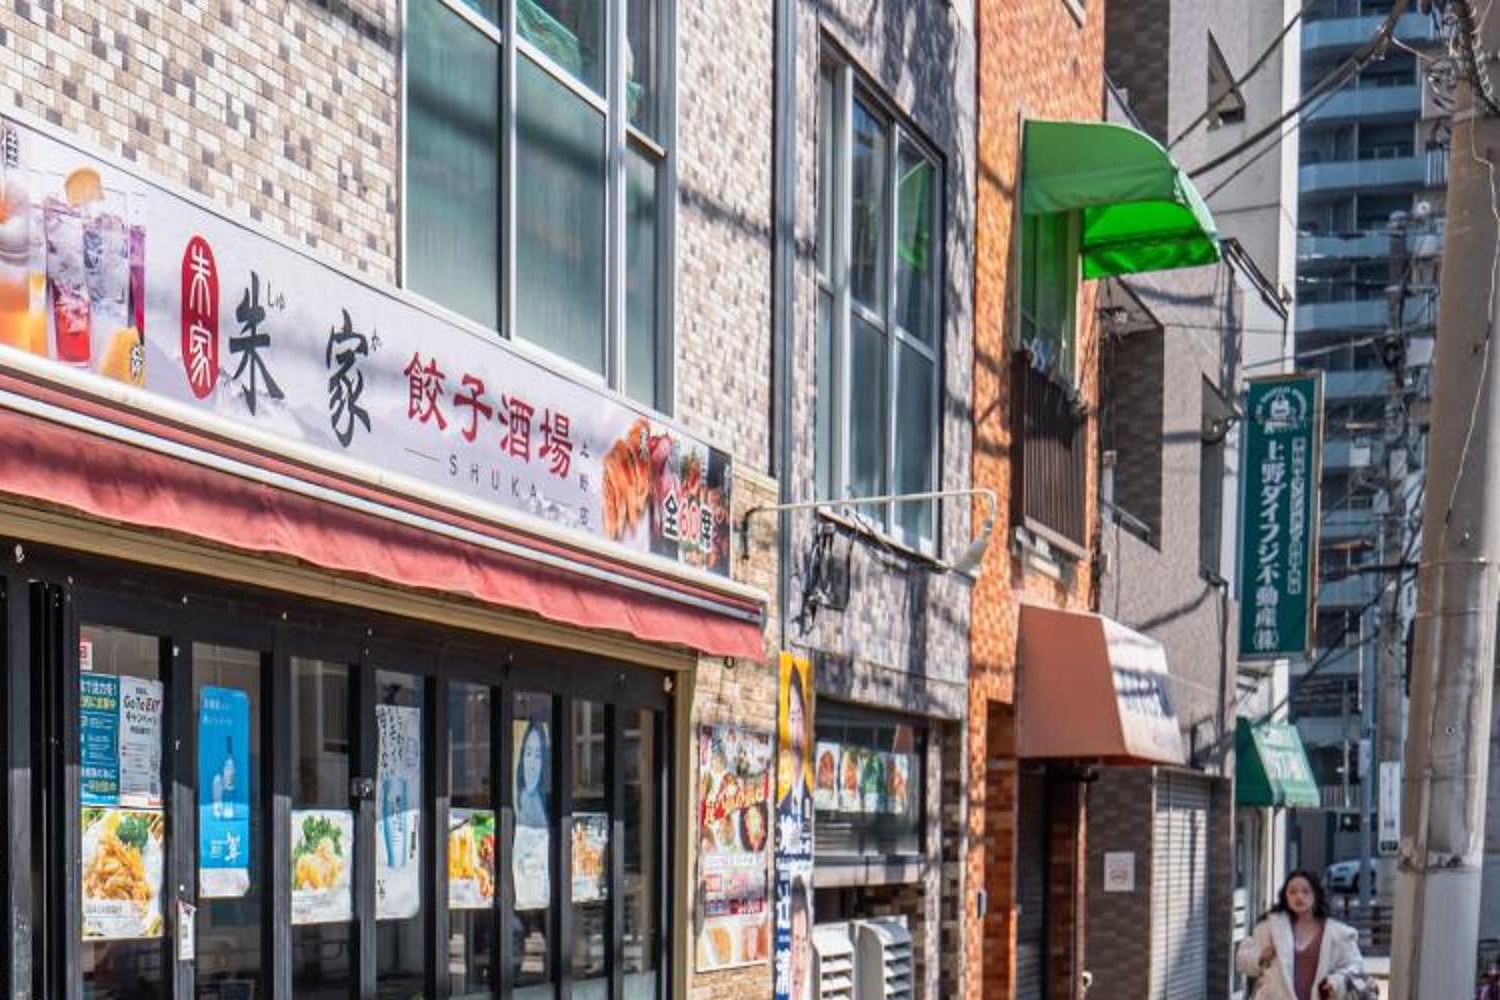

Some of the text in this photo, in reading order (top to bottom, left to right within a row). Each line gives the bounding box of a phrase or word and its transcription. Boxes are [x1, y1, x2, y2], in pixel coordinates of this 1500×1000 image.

[404, 352, 573, 479] 餃子酒場
[449, 453, 538, 499] SHUKA
